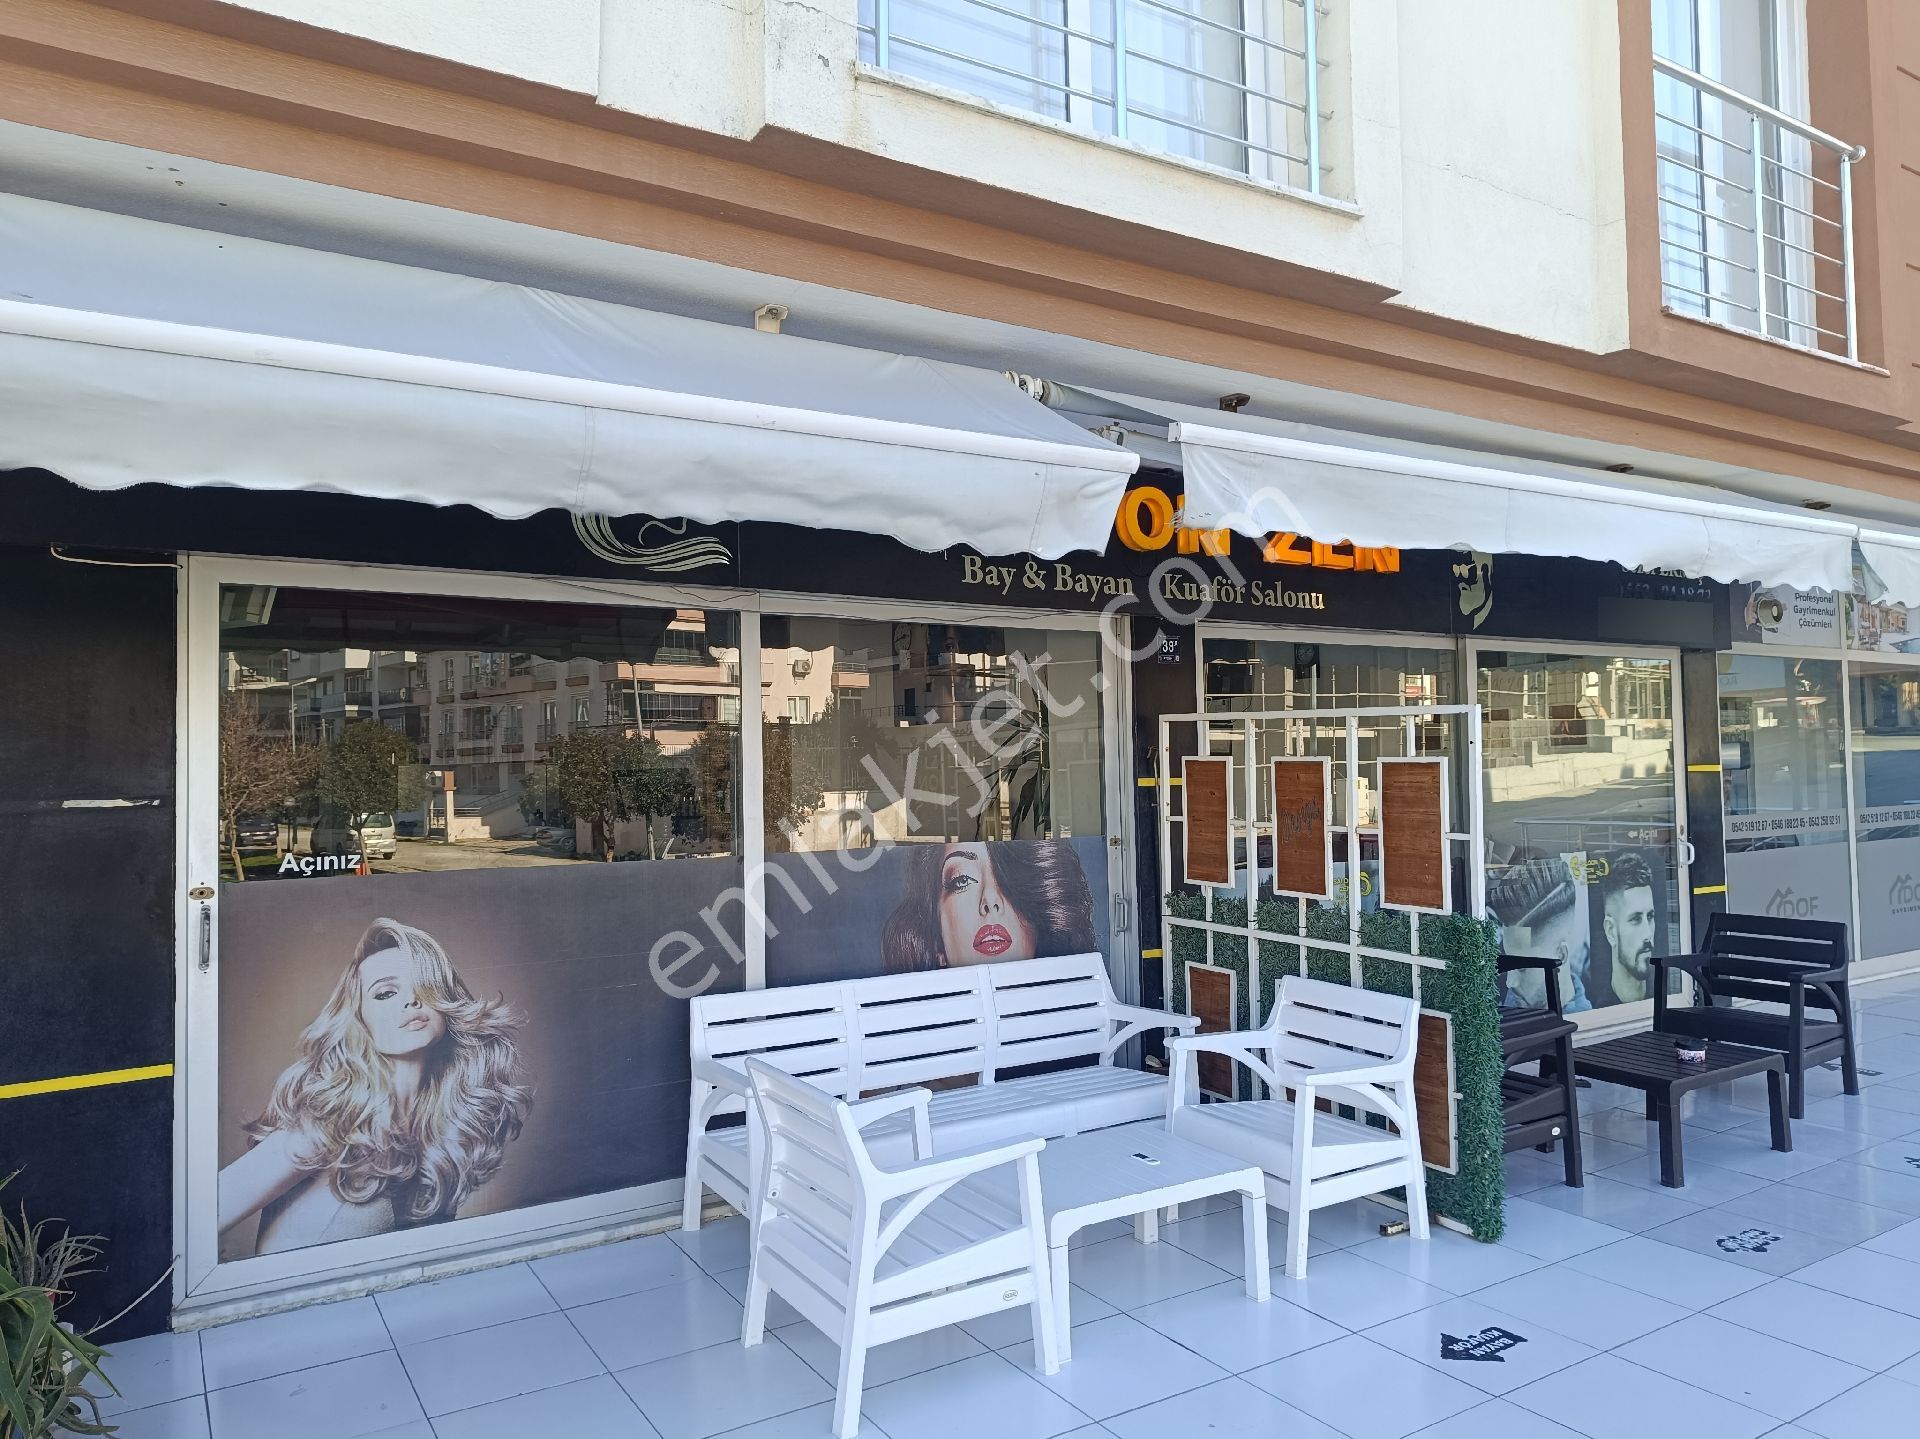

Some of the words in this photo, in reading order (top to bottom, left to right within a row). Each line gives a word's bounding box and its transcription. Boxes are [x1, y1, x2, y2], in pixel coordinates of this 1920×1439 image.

[962, 554, 1016, 596] Bay
[1022, 561, 1047, 591] &
[1053, 563, 1134, 602] Bayan
[1162, 573, 1246, 604] Kuaför
[1251, 580, 1325, 610] Salonu
[1794, 592, 1834, 604] Profesyonel
[1793, 604, 1836, 617] Gayrimenkul
[278, 852, 361, 876] Açınız
[1469, 1337, 1514, 1356] BAYAN
